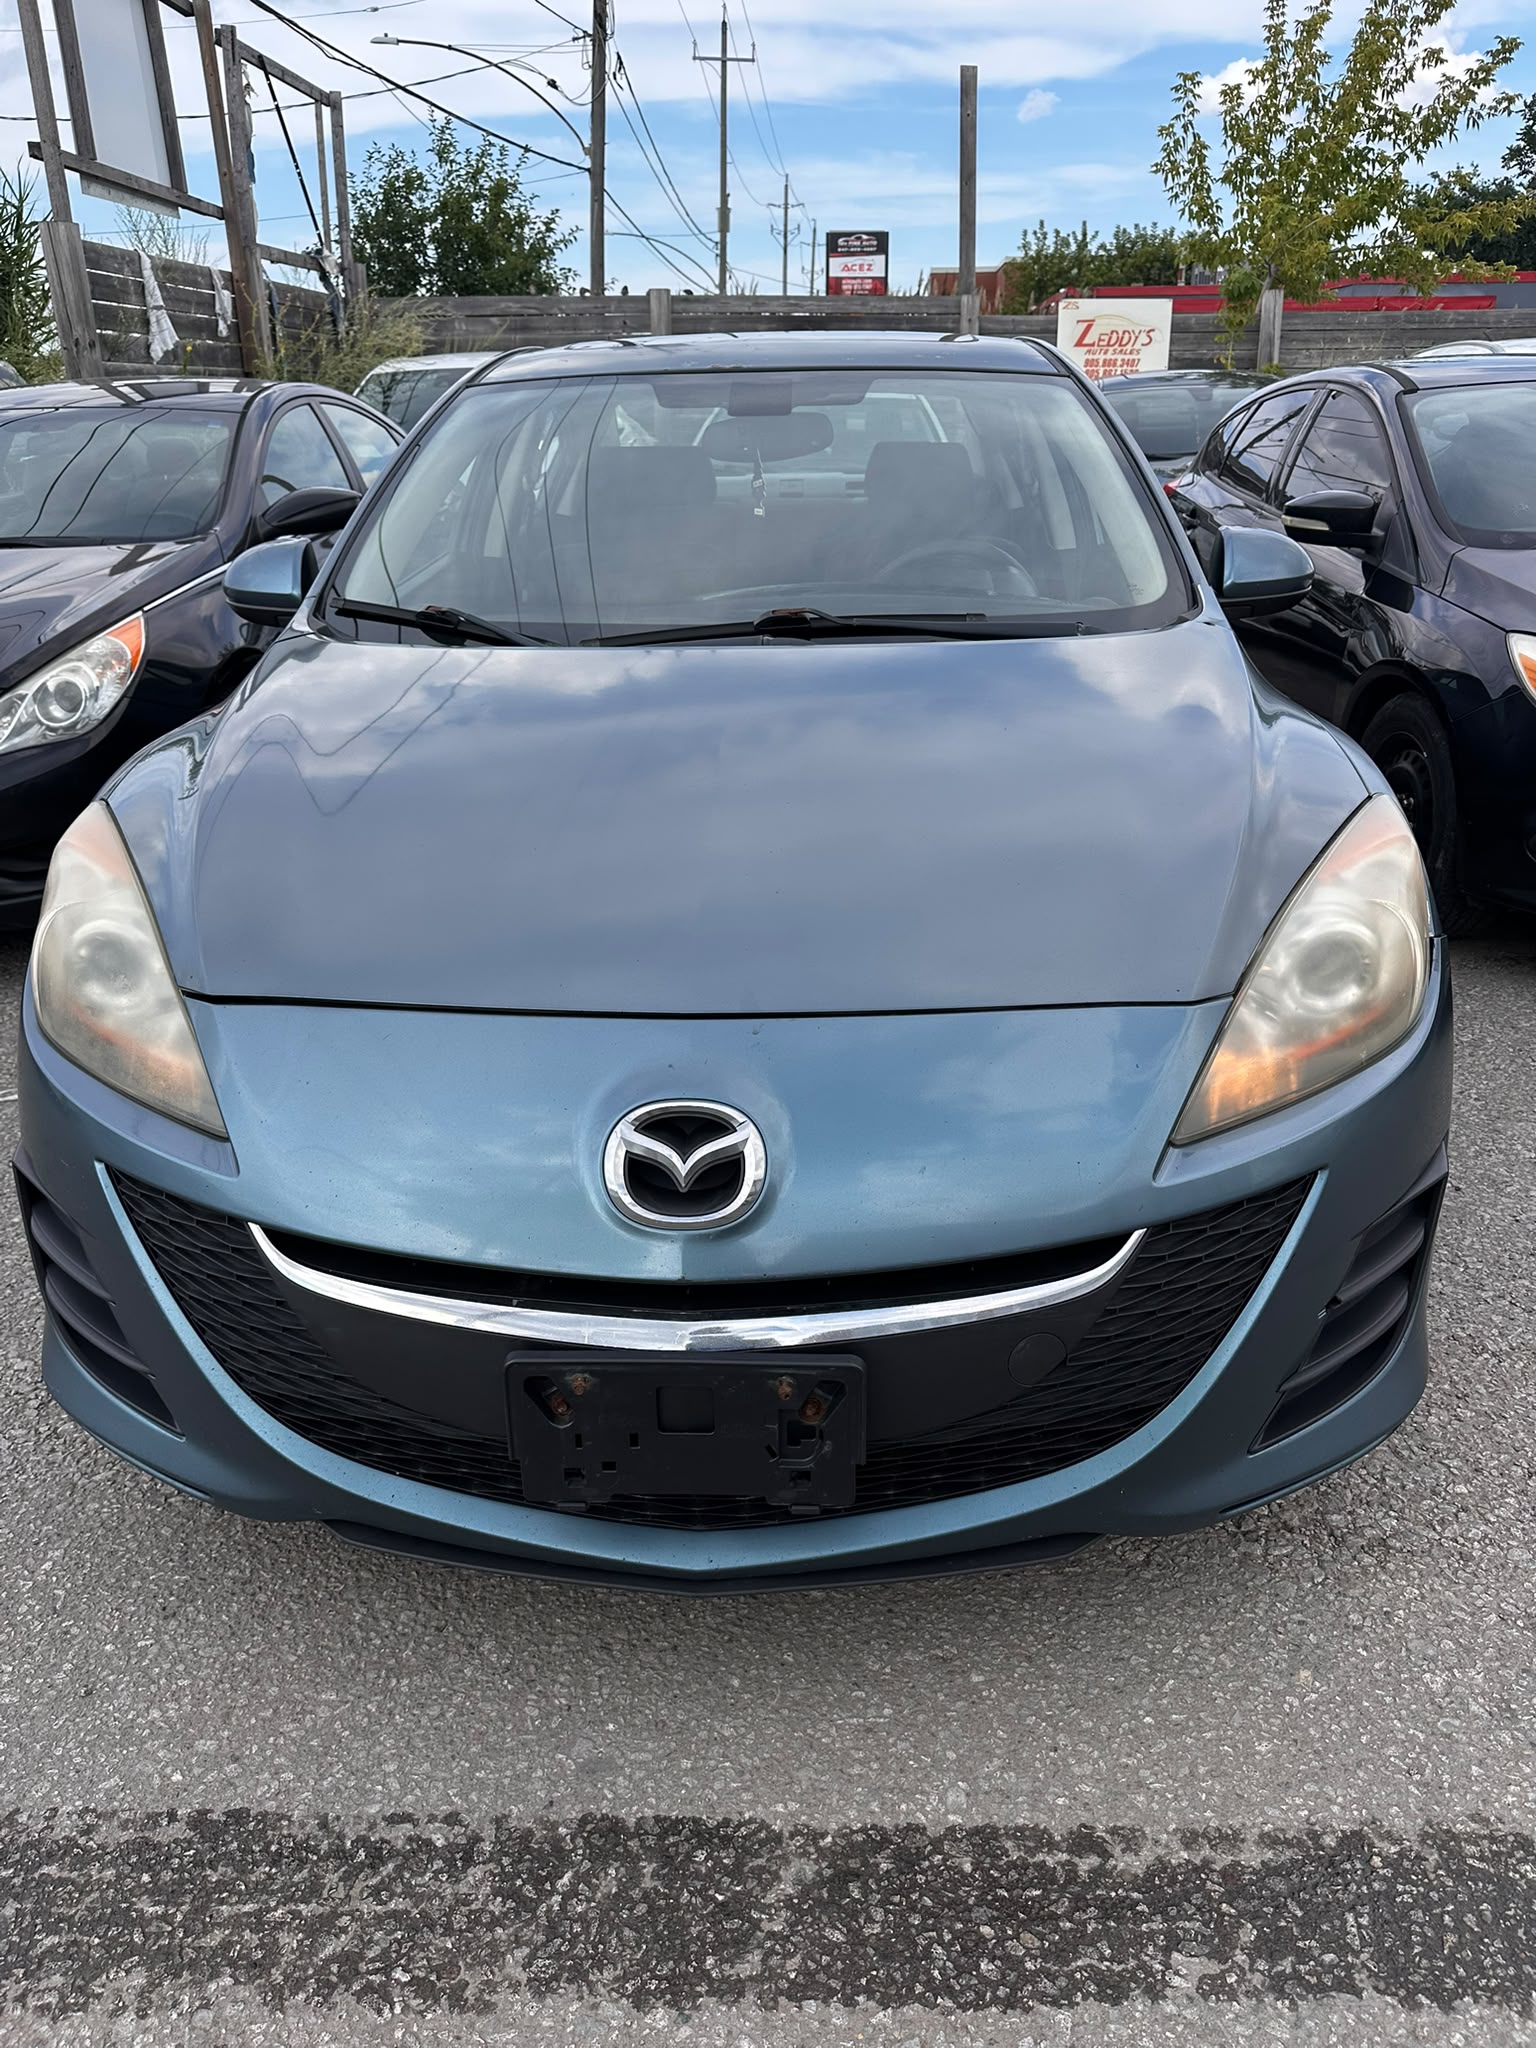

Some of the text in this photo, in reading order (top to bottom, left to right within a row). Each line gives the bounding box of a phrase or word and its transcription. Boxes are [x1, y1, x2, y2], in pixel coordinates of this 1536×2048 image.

[841, 264, 873, 272] ACEZ
[1074, 319, 1155, 347] ZEDDY'S
[1084, 348, 1142, 356] AUTO SALES
